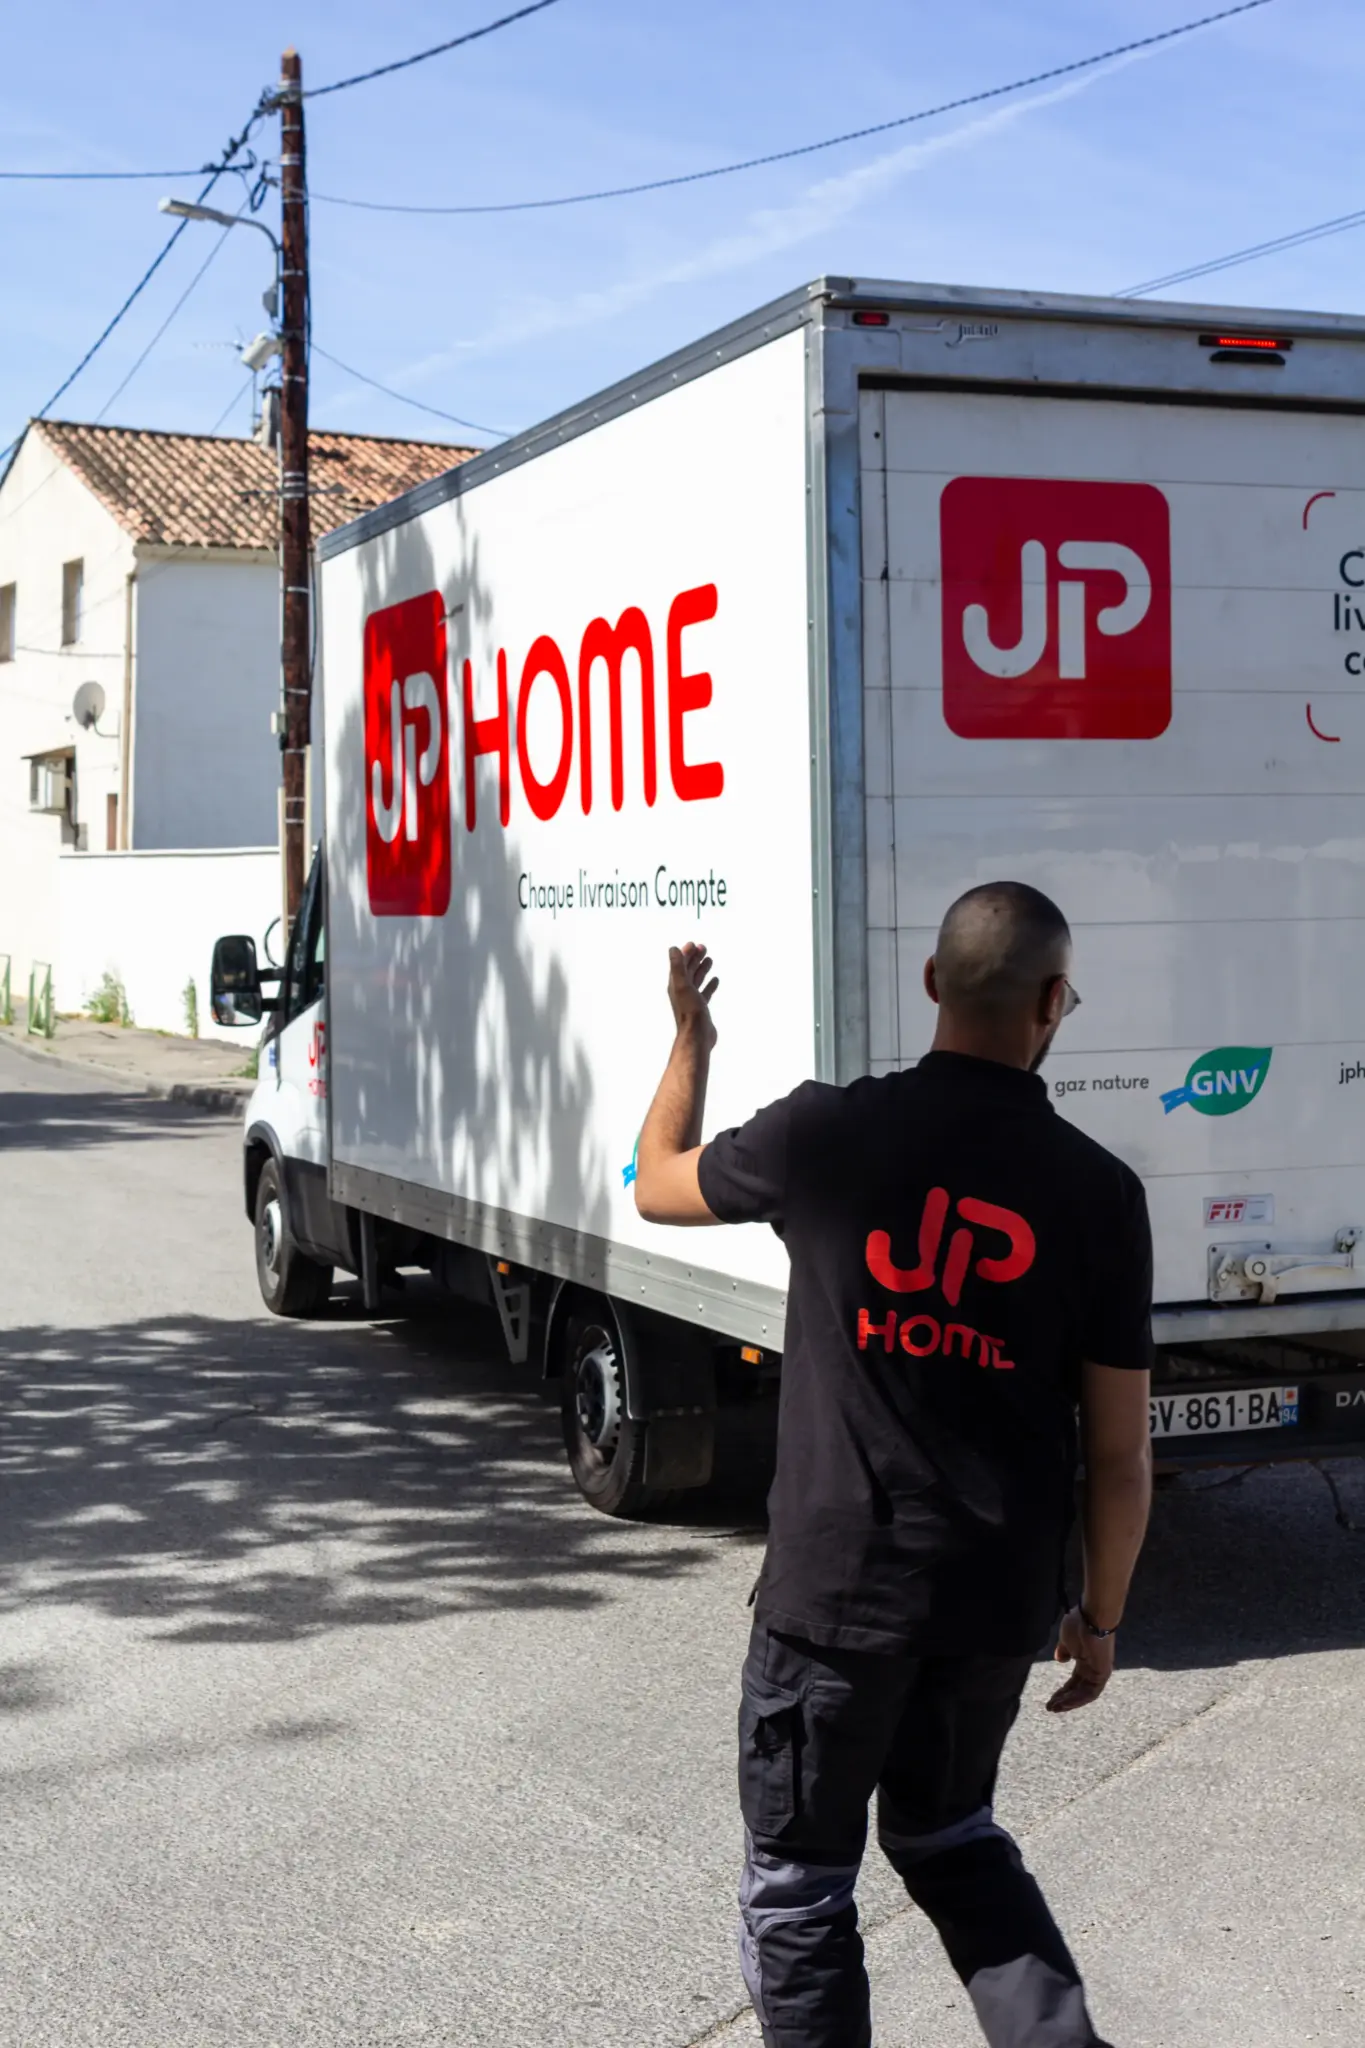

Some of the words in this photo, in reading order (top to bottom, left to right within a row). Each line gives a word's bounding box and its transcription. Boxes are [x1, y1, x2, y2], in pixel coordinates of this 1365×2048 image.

[962, 539, 1152, 679] JP
[371, 671, 441, 843] JP
[463, 583, 724, 832] HOME
[518, 872, 574, 919] Chaque
[579, 868, 649, 908] livraison
[655, 865, 727, 919] Compte
[1055, 1080, 1086, 1097] gaz
[1092, 1074, 1149, 1090] nature
[1191, 1068, 1260, 1096] GNV
[865, 1186, 1036, 1306] JP
[857, 1308, 1015, 1369] HOME
